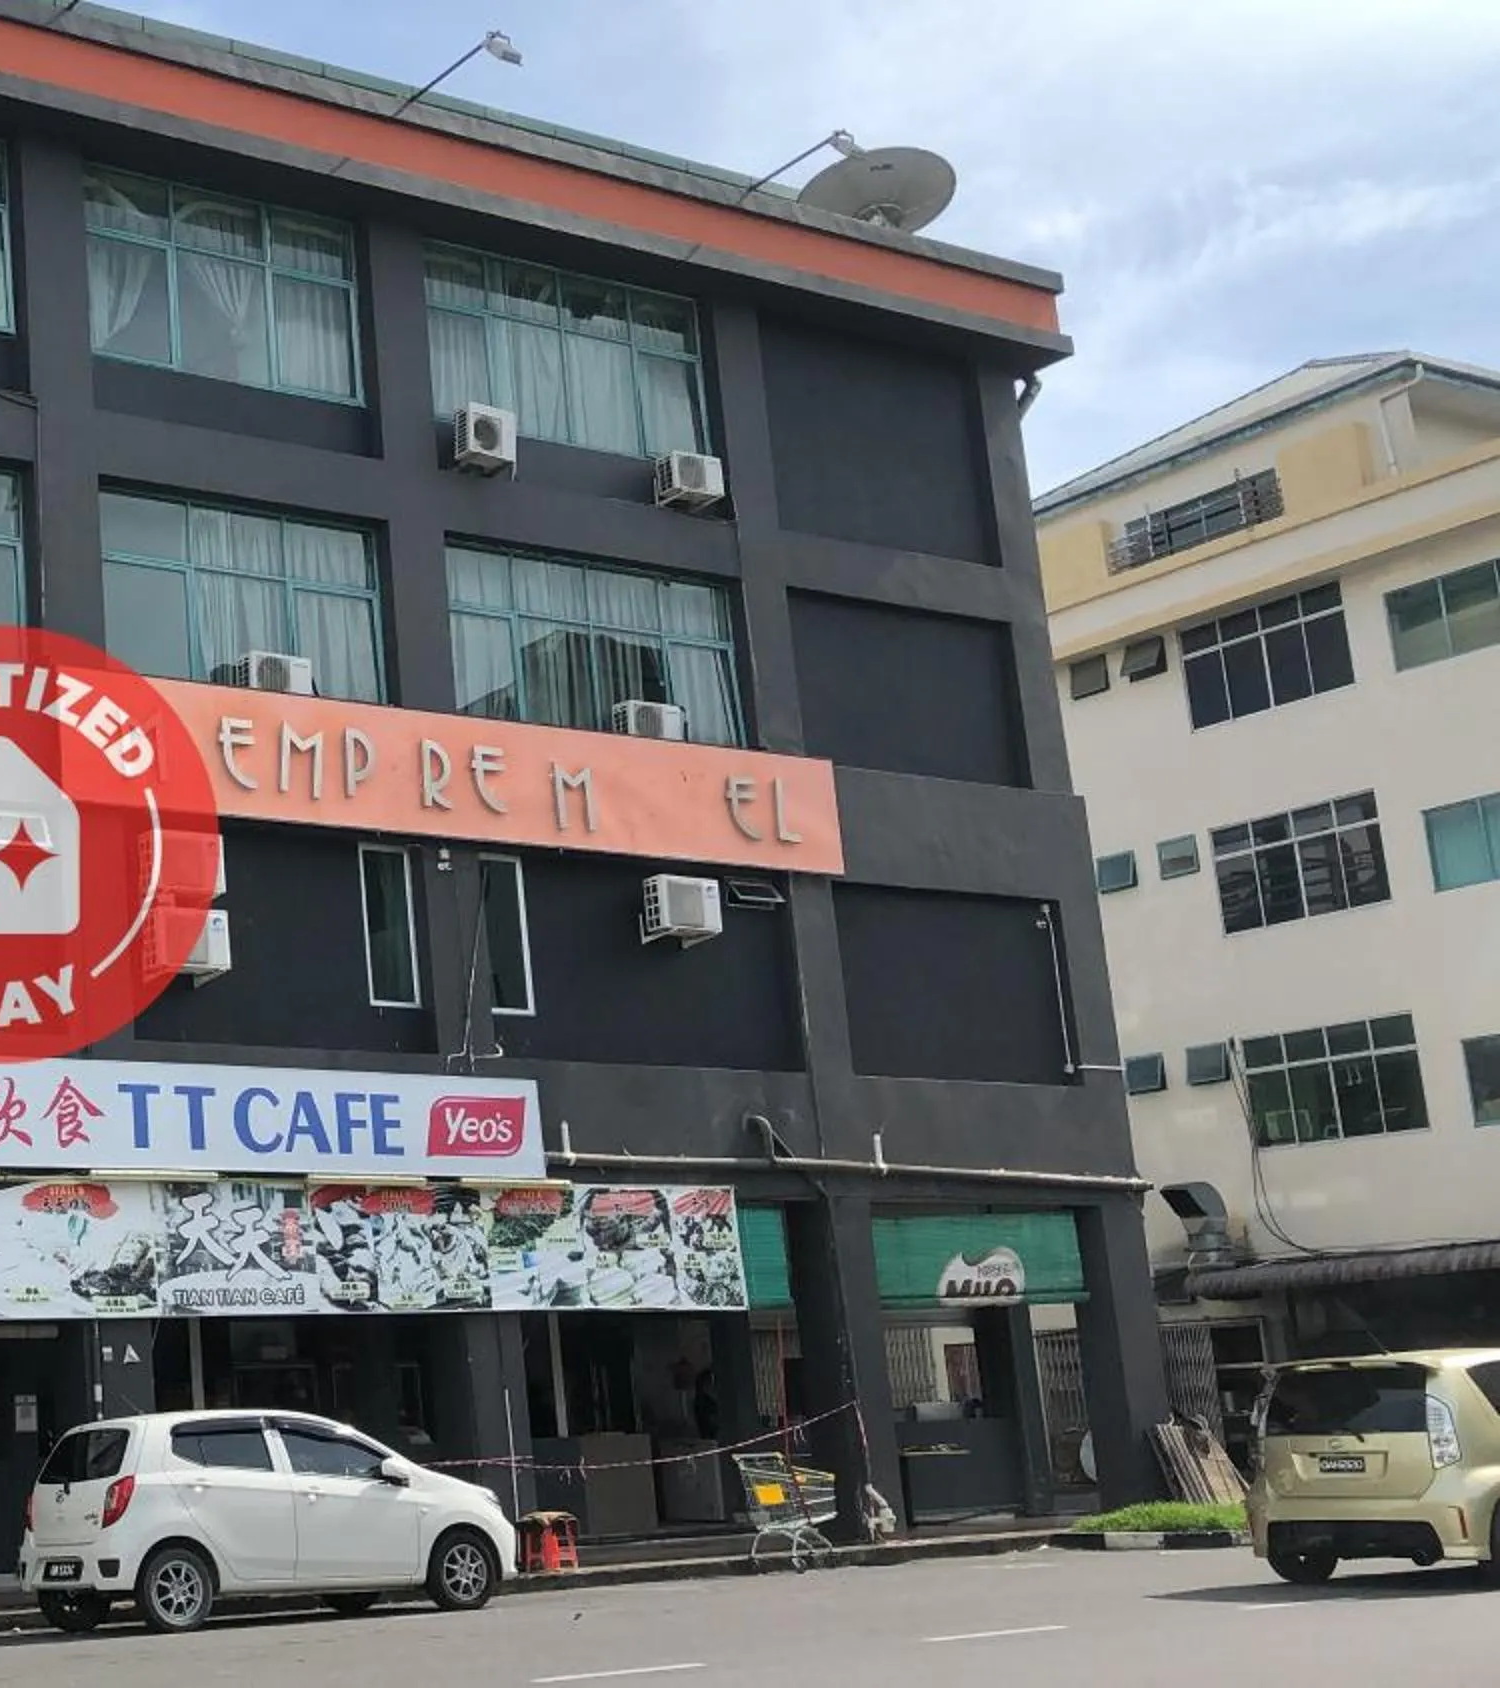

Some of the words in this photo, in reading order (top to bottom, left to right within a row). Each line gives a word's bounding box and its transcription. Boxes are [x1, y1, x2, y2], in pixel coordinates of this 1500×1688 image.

[233, 1086, 405, 1156] CAFE
[444, 1106, 513, 1145] Yeo's
[175, 1192, 293, 1281] 天天
[173, 1288, 215, 1306] TIAN
[216, 1288, 257, 1306] TIAN
